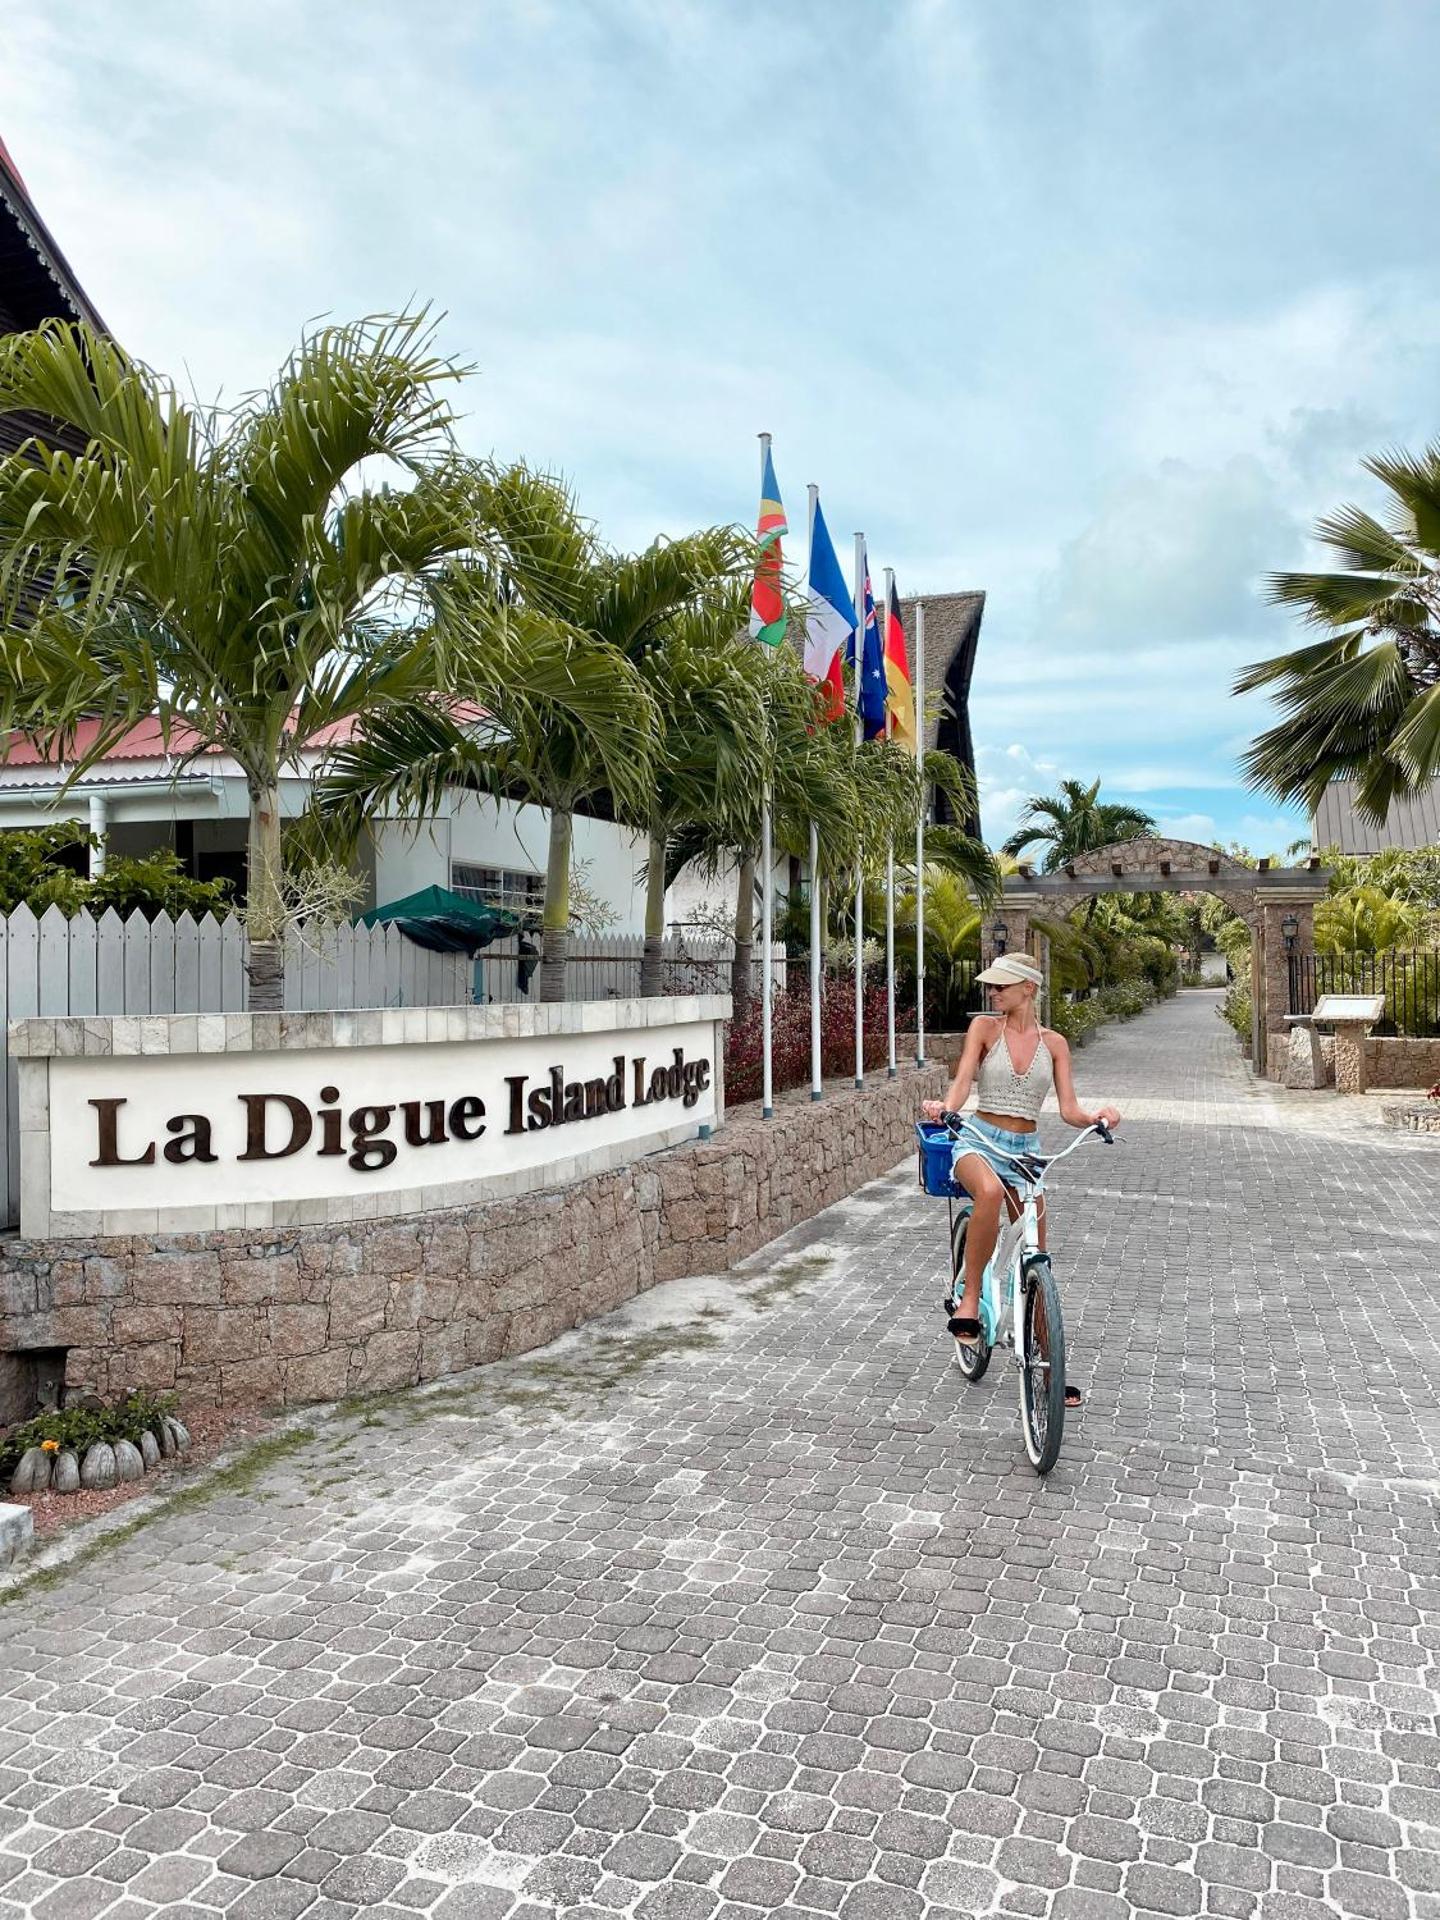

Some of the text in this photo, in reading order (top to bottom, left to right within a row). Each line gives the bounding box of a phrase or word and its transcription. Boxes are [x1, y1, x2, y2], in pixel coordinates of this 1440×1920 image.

[87, 1047, 711, 1172] La Digue Island Lodge
